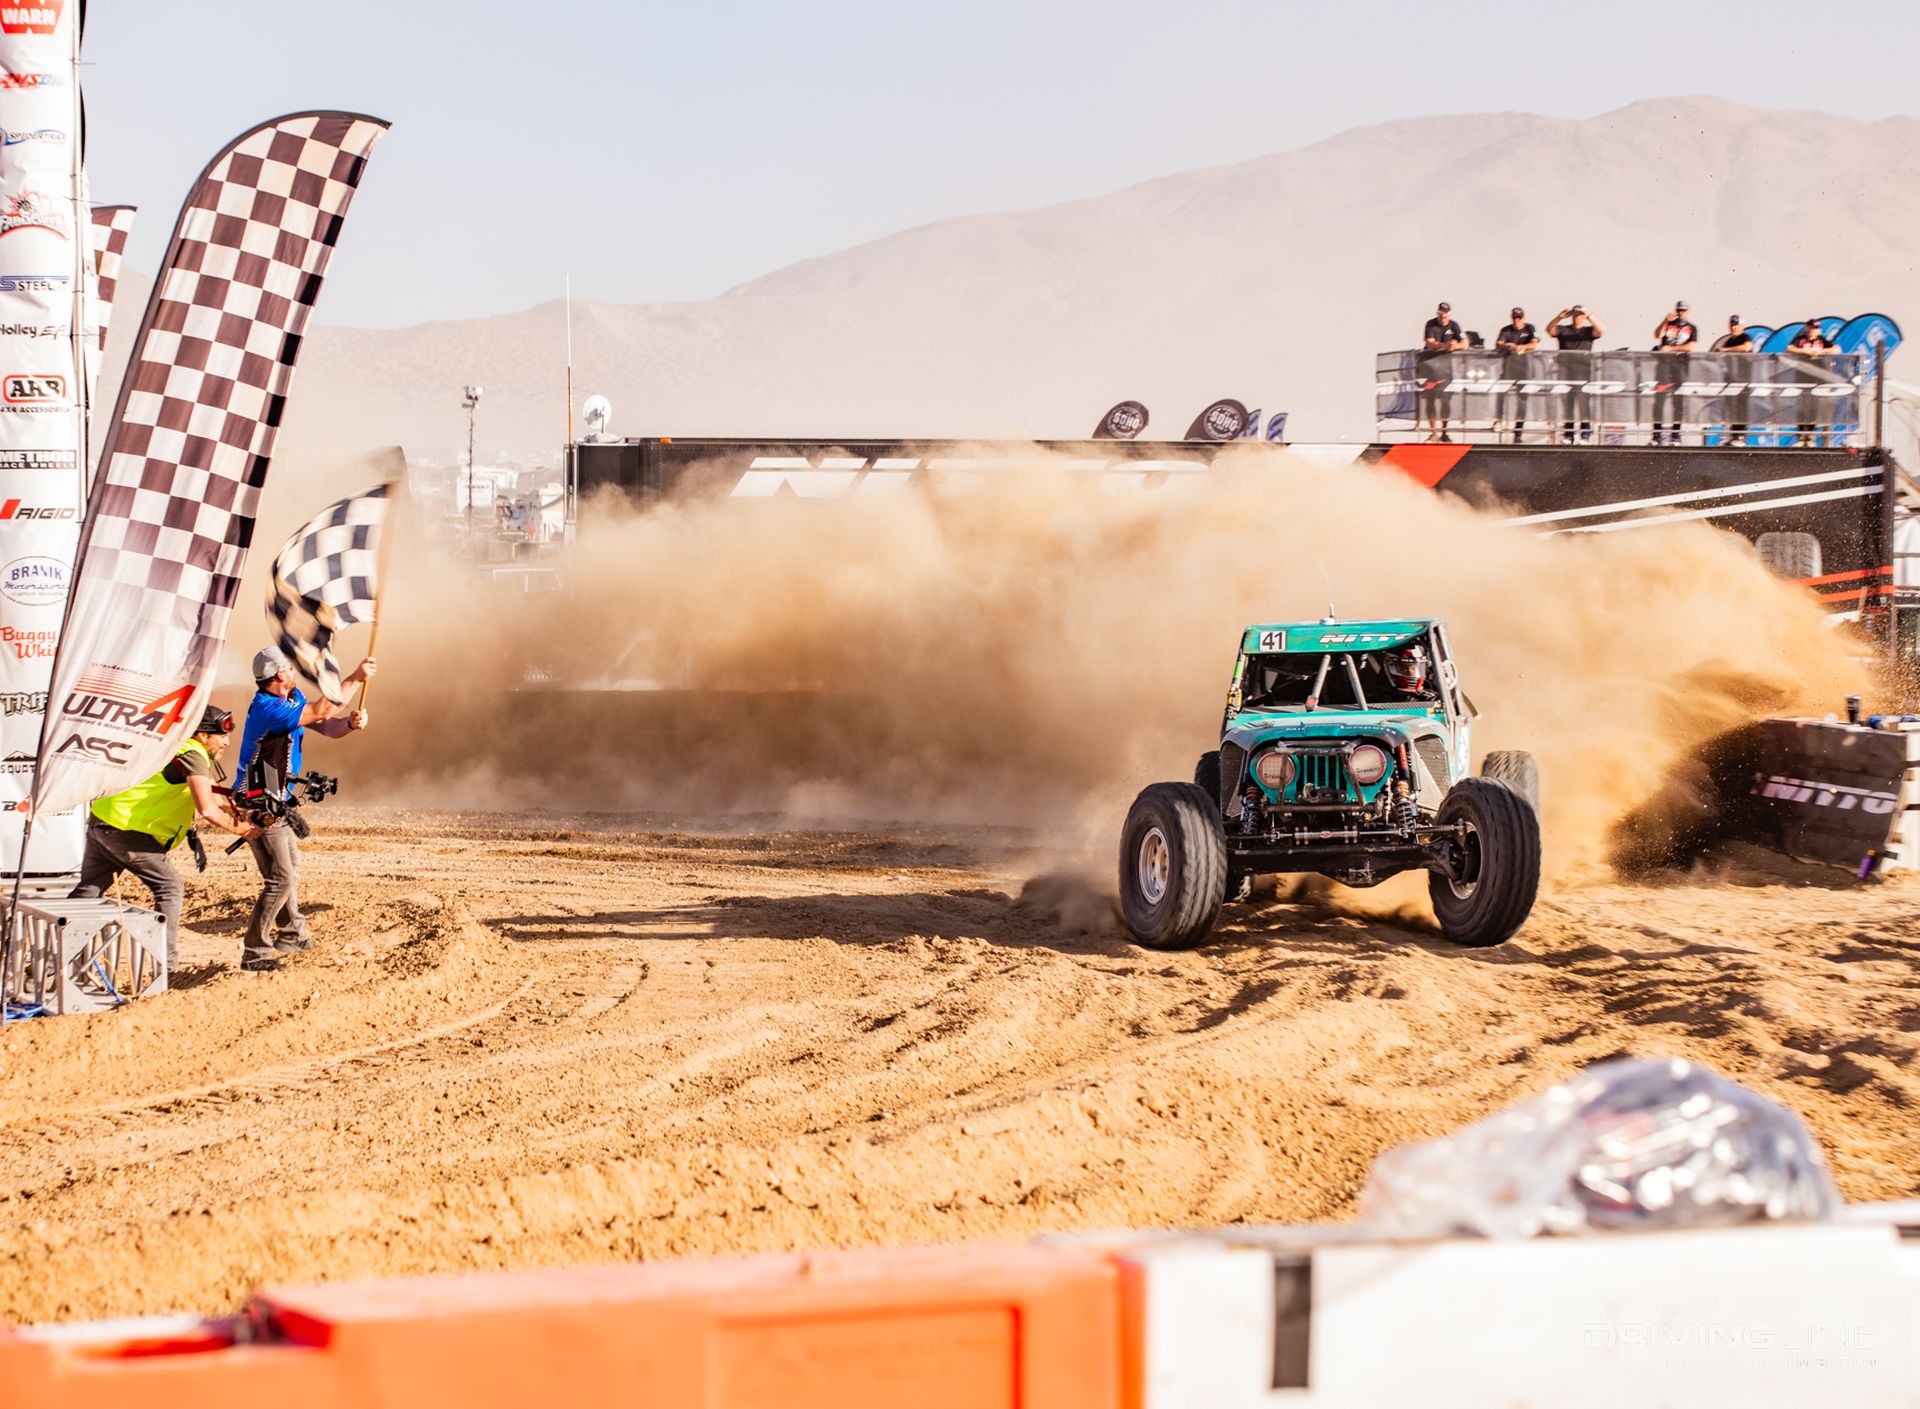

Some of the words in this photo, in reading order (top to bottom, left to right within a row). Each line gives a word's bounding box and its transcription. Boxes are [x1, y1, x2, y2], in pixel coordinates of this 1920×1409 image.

[1, 8, 55, 25] WARN
[1444, 379, 1627, 393] NITTO
[1674, 382, 1856, 396] NITTO
[16, 508, 75, 519] RIGID
[0, 626, 56, 643] Buggy
[1262, 632, 1283, 650] 41
[62, 684, 196, 735] ULTRA4
[55, 733, 133, 765] ASC
[1762, 775, 1898, 814] NITTO
